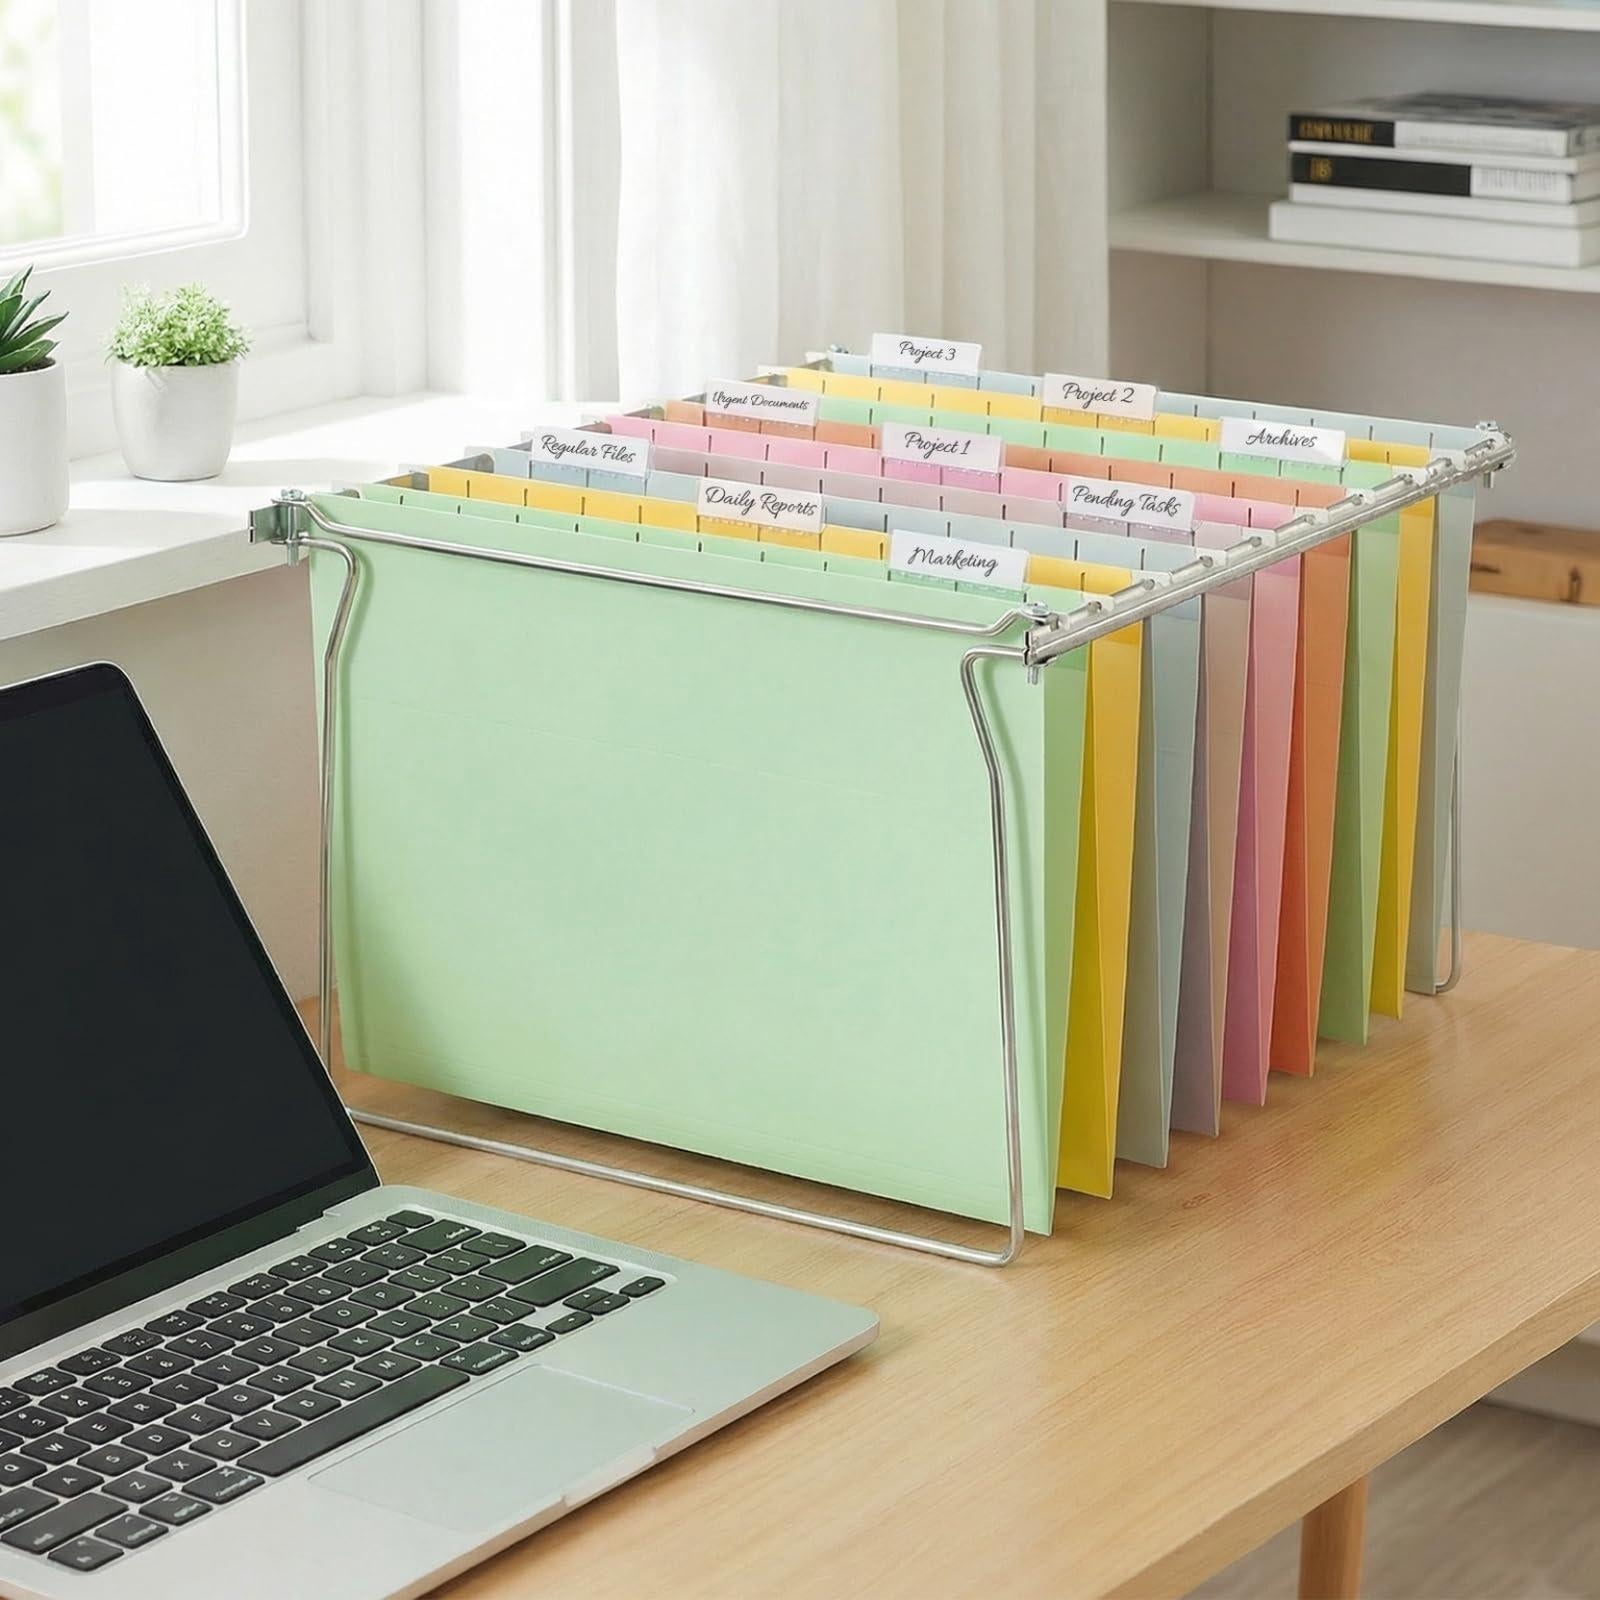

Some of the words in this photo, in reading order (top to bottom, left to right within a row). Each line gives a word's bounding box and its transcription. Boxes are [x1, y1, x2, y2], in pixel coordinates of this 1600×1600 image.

[899, 341, 944, 363] Project
[945, 348, 957, 361] 3
[712, 391, 749, 409] Urgent
[750, 394, 810, 411] Documents
[1062, 382, 1117, 409] Project
[1119, 387, 1135, 403] 2
[541, 434, 597, 460] Regular
[601, 444, 637, 463] Files
[904, 431, 958, 459] Project
[960, 439, 972, 455] 1
[1245, 428, 1318, 448] Archives
[705, 486, 756, 515] Daily
[760, 492, 818, 518] Reports
[1072, 485, 1136, 517] Pending
[1138, 493, 1182, 517] Tasks
[907, 546, 999, 578] Marketing
